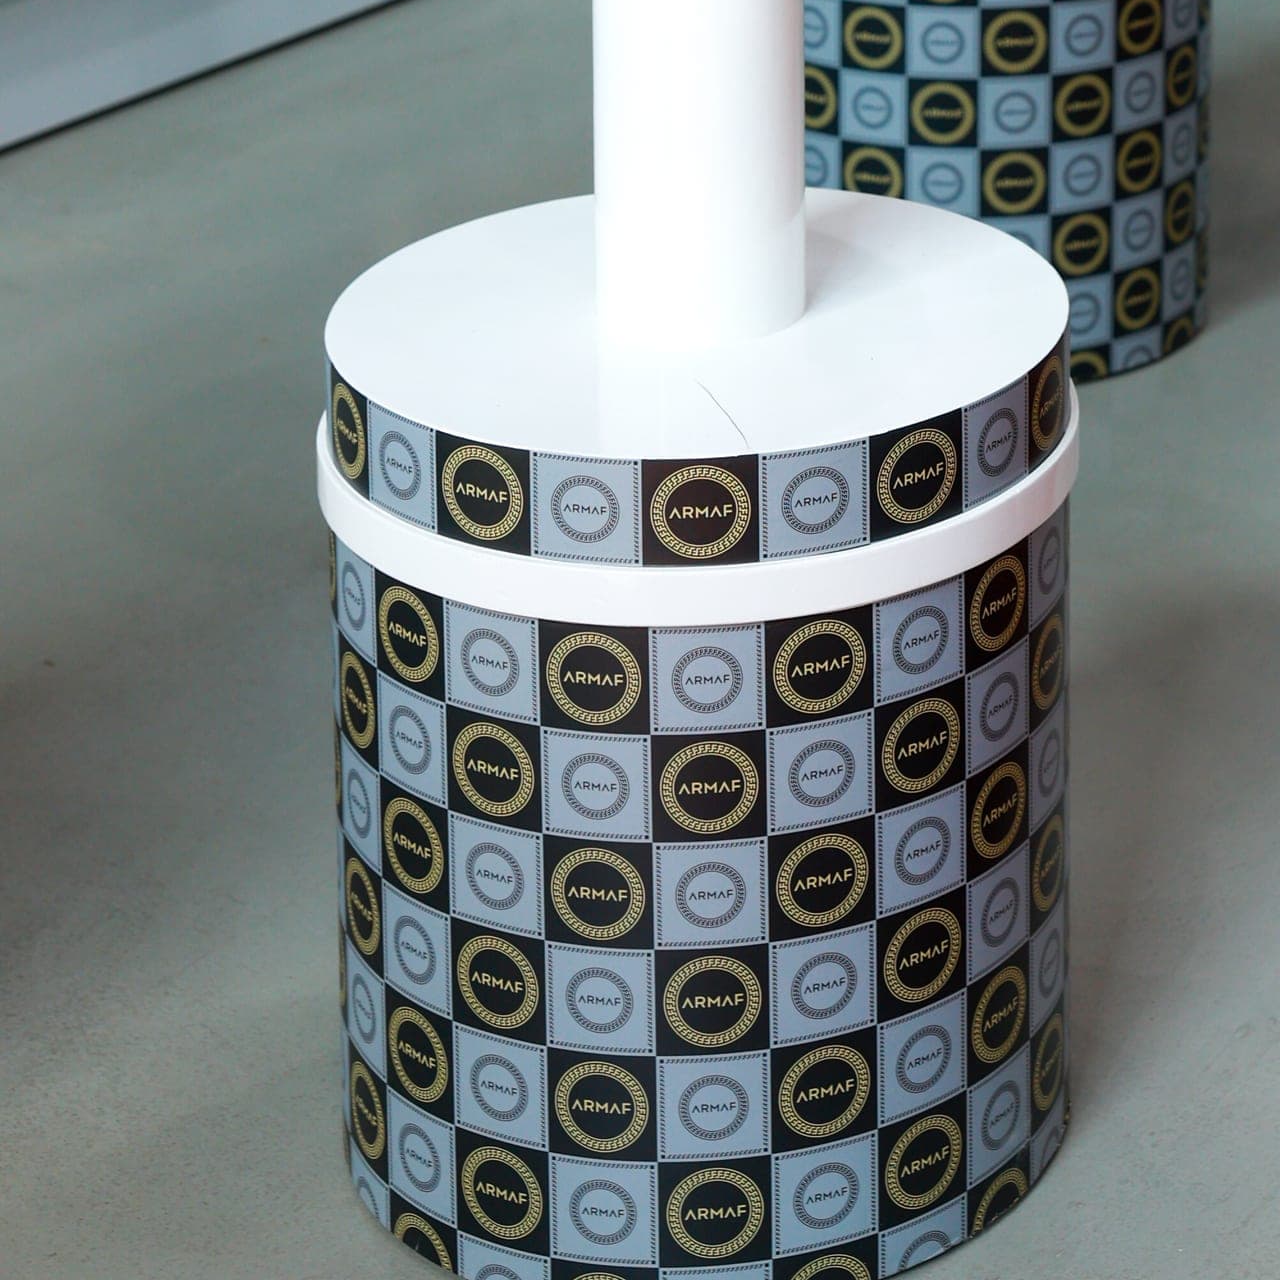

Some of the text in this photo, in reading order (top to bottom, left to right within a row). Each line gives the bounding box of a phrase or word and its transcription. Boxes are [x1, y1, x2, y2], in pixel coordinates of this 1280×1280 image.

[985, 435, 1012, 452] ARMAF
[386, 457, 412, 474] ARMAF
[893, 462, 943, 489] ARMAF
[456, 483, 507, 503] ARMAF
[795, 492, 837, 507] ARMAF
[564, 504, 606, 515] ARMAF
[669, 505, 732, 519] ARMAF
[982, 587, 1016, 619] ARMAF
[389, 622, 426, 647] ARMAF
[904, 630, 939, 650] ARMAF
[472, 656, 508, 670] ARMAF
[792, 655, 849, 677] ARMAF
[564, 671, 623, 686] ARMAF
[685, 674, 730, 685] ARMAF
[988, 697, 1012, 718] ARMAF
[394, 732, 422, 749] ARMAF
[898, 731, 947, 759] ARMAF
[467, 759, 518, 780] ARMAF
[802, 765, 843, 781] ARMAF
[574, 781, 617, 792] ARMAF
[679, 780, 740, 794] ARMAF
[983, 793, 1017, 827] ARMAF
[394, 832, 431, 858] ARMAF
[906, 840, 941, 861] ARMAF
[476, 869, 513, 884] ARMAF
[794, 868, 852, 891] ARMAF
[568, 887, 627, 901] ARMAF
[689, 889, 733, 900] ARMAF
[401, 941, 427, 959] ARMAF
[899, 940, 948, 970] ARMAF
[472, 972, 523, 993] ARMAF
[804, 977, 845, 994] ARMAF
[578, 995, 621, 1006] ARMAF
[682, 993, 744, 1008] ARMAF
[984, 996, 1017, 1032] ARMAF
[399, 1041, 436, 1068] ARMAF
[907, 1048, 942, 1070] ARMAF
[481, 1080, 517, 1096] ARMAF
[797, 1079, 854, 1103] ARMAF
[572, 1099, 631, 1114] ARMAF
[691, 1102, 736, 1113] ARMAF
[406, 1148, 432, 1168] ARMAF
[901, 1146, 949, 1177] ARMAF
[476, 1182, 527, 1204] ARMAF
[806, 1187, 848, 1204] ARMAF
[582, 1207, 624, 1217] ARMAF
[685, 1205, 746, 1220] ARMAF
